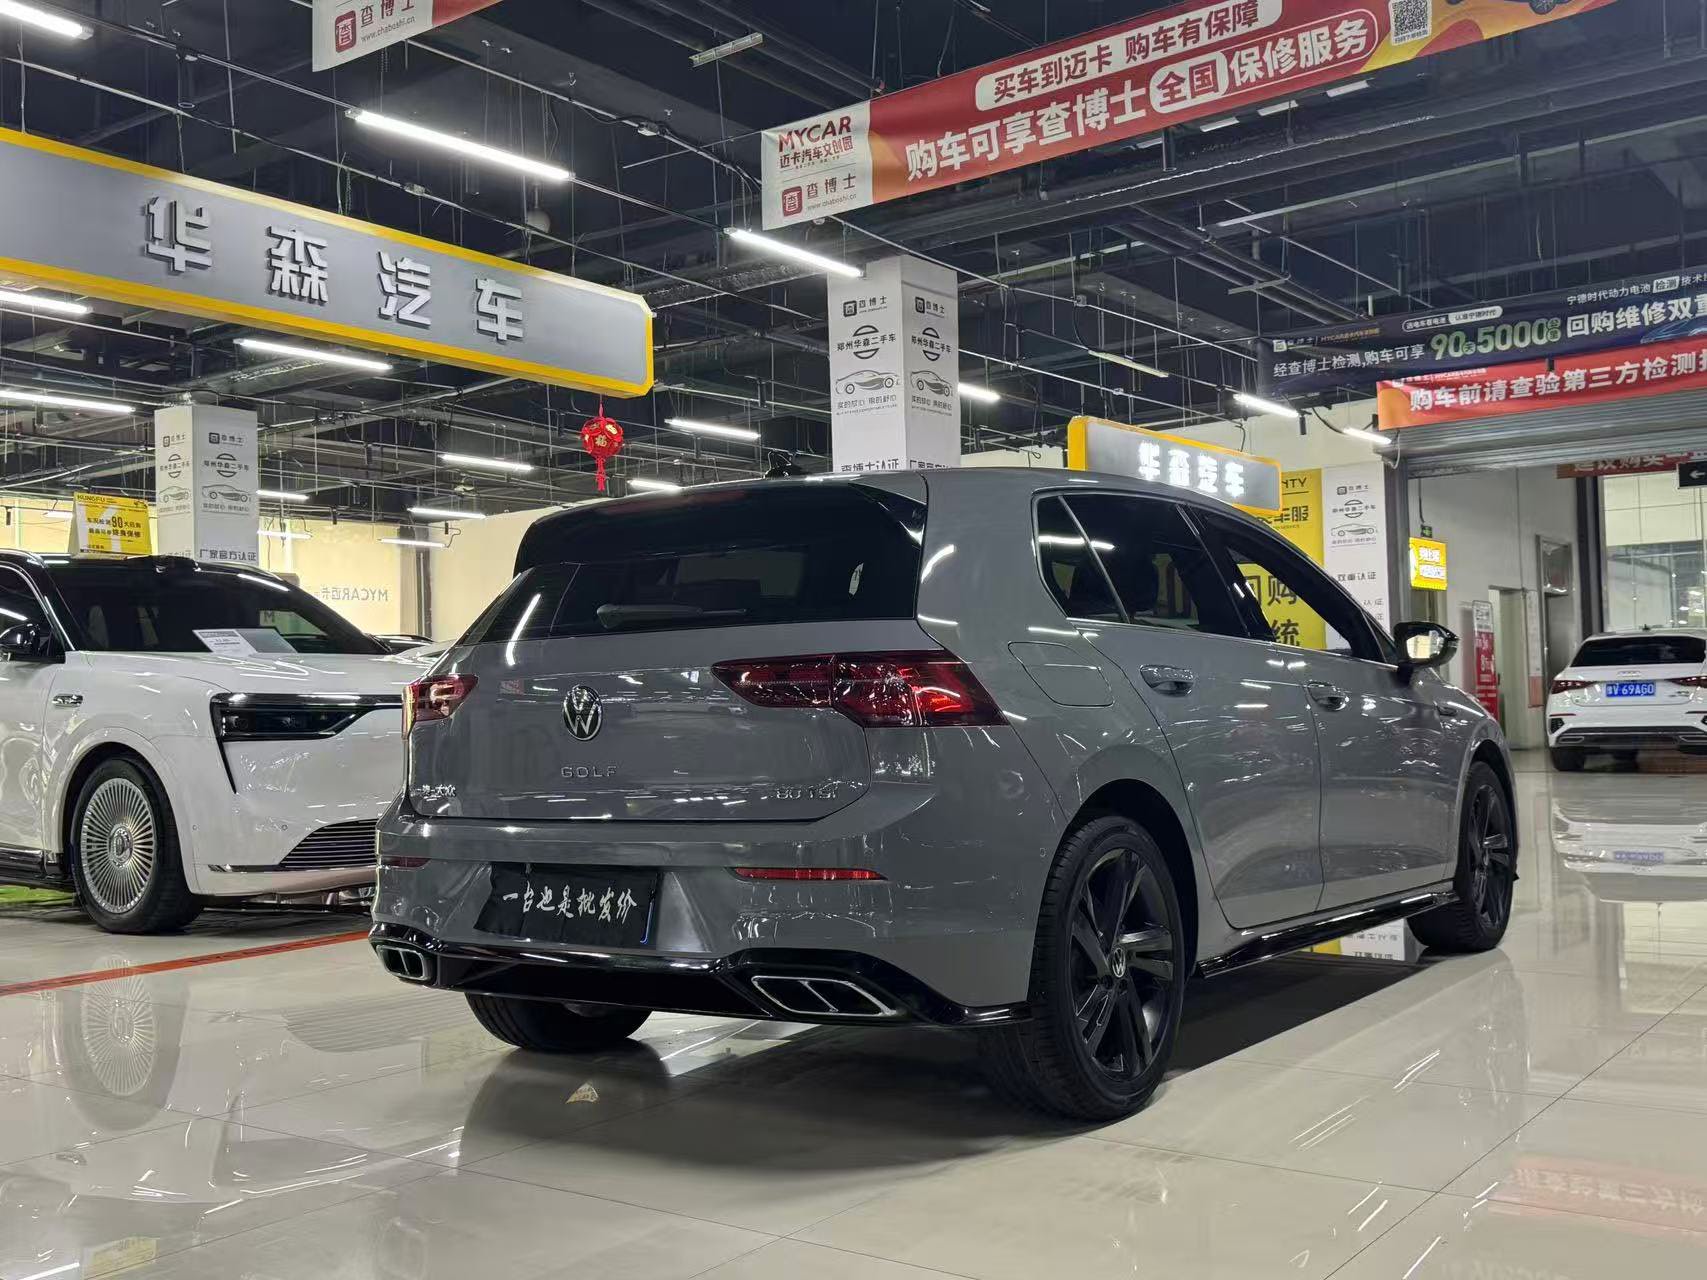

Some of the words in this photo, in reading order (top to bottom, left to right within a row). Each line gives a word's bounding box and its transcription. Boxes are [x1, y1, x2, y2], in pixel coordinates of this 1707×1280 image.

[361, 15, 416, 43] www.chaboshi.cn
[994, 44, 1113, 103] 买车到迈卡
[1125, 2, 1260, 63] 购车有保障
[778, 116, 852, 153] MYCAR
[905, 80, 1147, 181] 购车可享查博士
[780, 135, 853, 169] 迈卡汽车文创园
[806, 172, 857, 200] 查博士
[144, 195, 524, 344] 华森汽车
[1567, 283, 1651, 306] 宁德时代动力电池
[1681, 272, 1707, 287] 技术
[1273, 343, 1425, 378] 经查博士检测,购车可享
[1410, 348, 1707, 412] 购车前请查验第三方检测
[560, 765, 618, 779] GOLF
